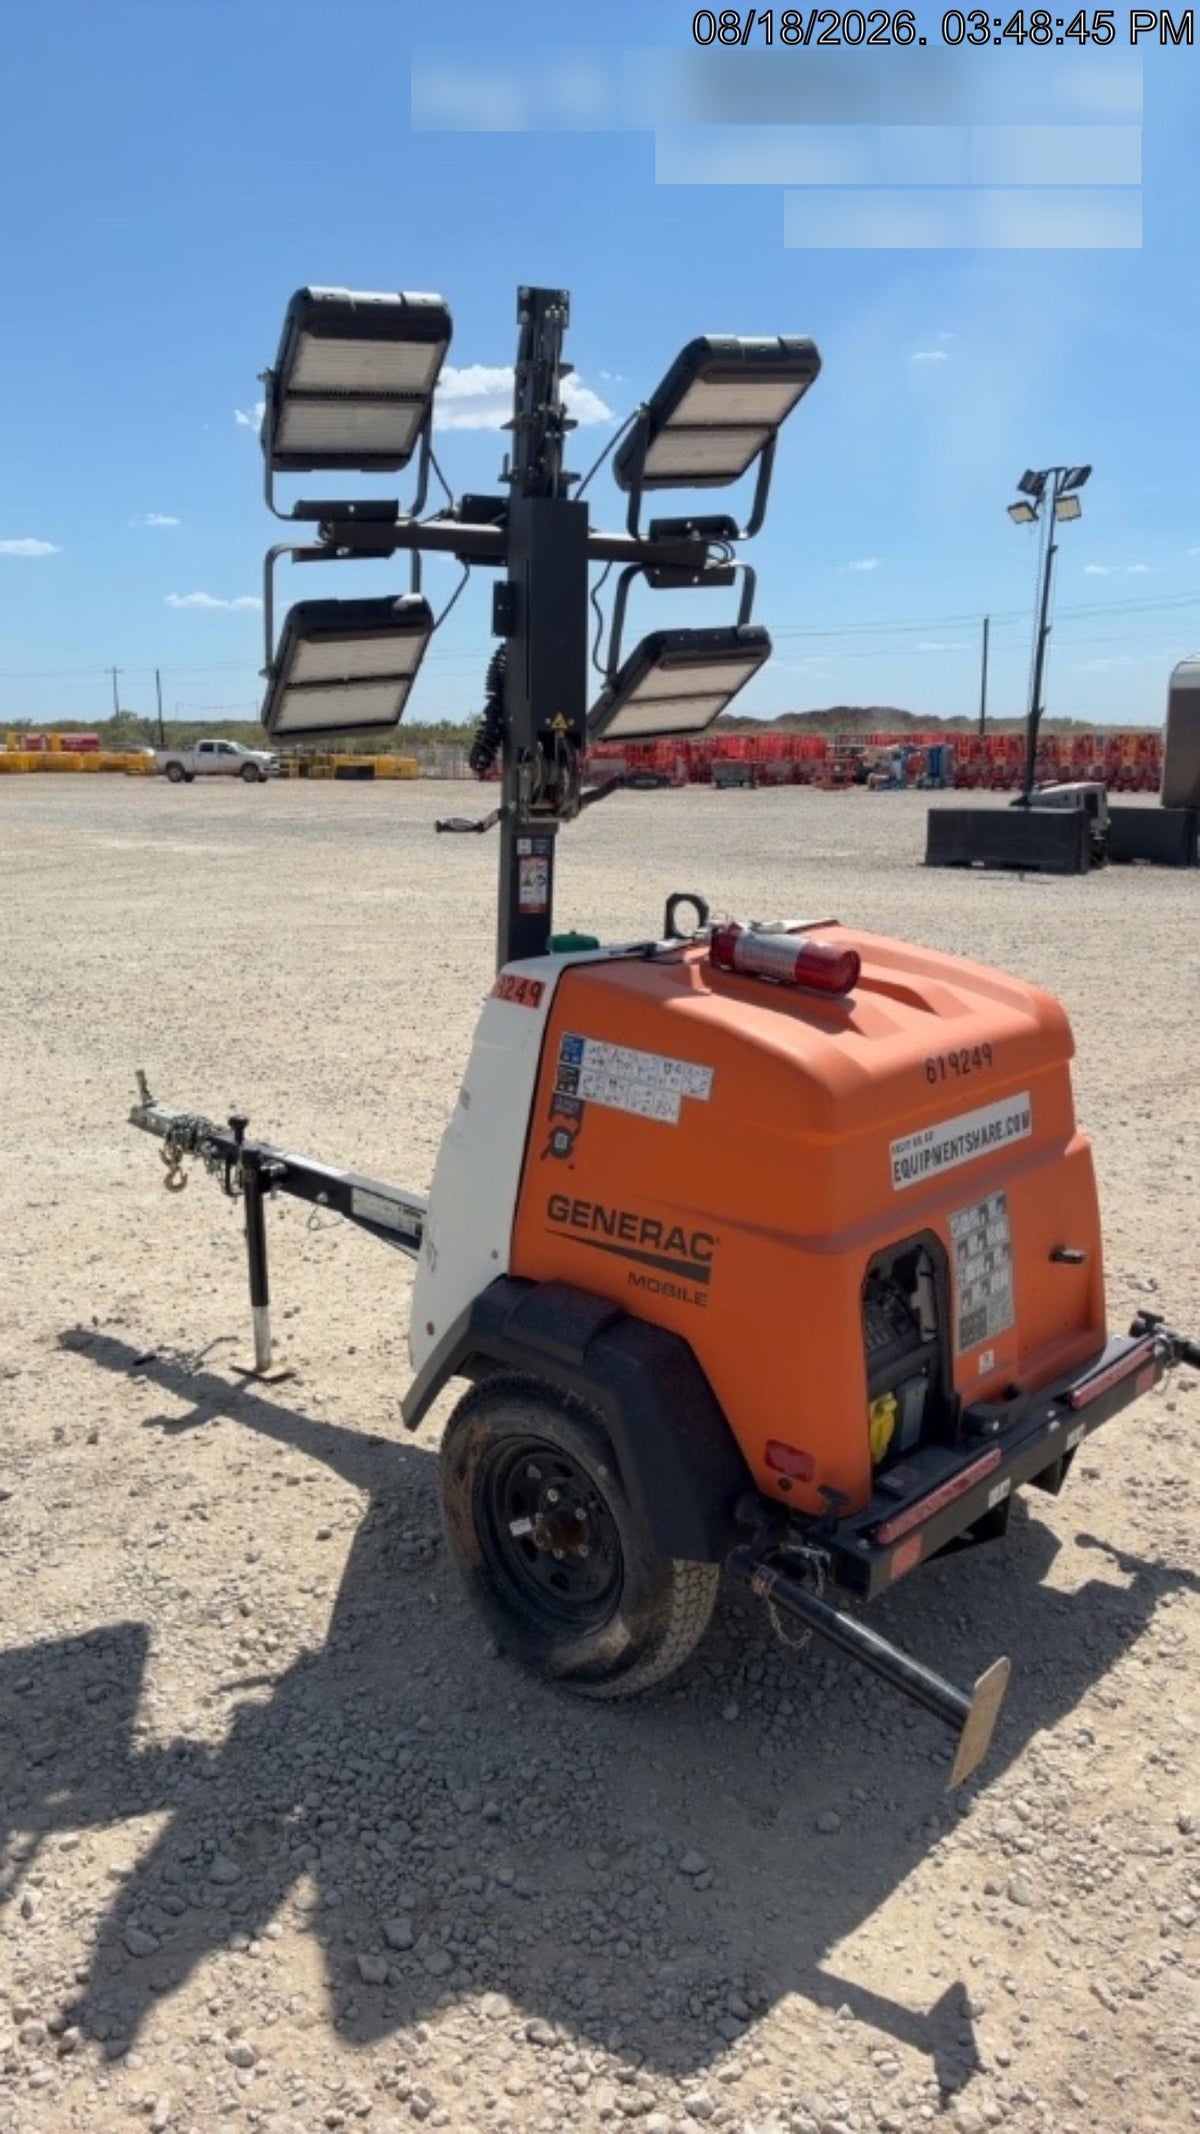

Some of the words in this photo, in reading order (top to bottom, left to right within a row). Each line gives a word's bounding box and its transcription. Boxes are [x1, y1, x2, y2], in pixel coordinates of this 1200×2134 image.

[924, 1042, 993, 1084] 619249
[893, 1109, 1030, 1182] EQUIPMENTSHARE.COM
[547, 1193, 715, 1262] GENERAC
[627, 1271, 709, 1308] MOBILE
